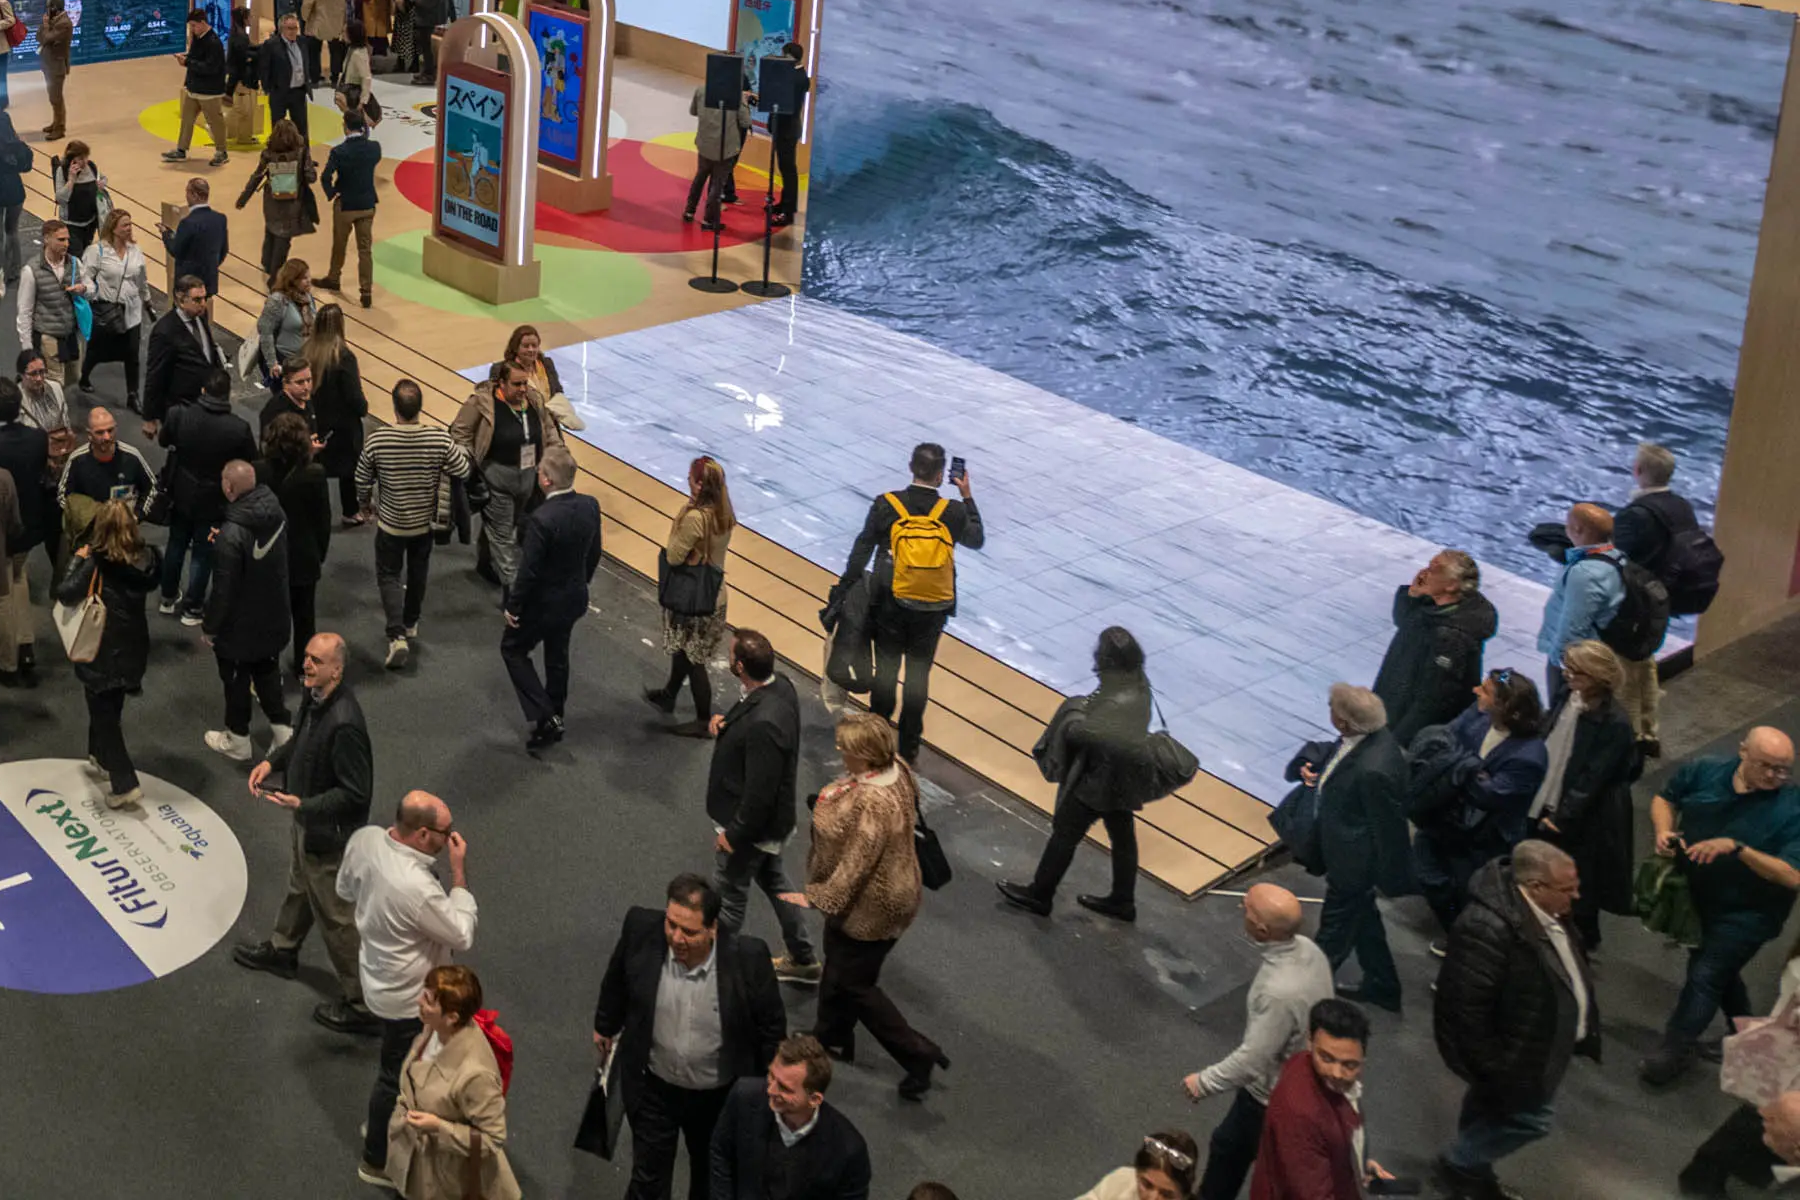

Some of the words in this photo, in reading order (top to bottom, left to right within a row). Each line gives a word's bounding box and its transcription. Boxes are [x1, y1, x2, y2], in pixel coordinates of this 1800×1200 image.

[447, 85, 504, 121] スペイン
[444, 198, 457, 216] ON
[457, 203, 473, 223] THE
[473, 208, 498, 233] ROAD
[81, 799, 176, 892] OBSERVATORIO
[157, 804, 209, 848] aqualia
